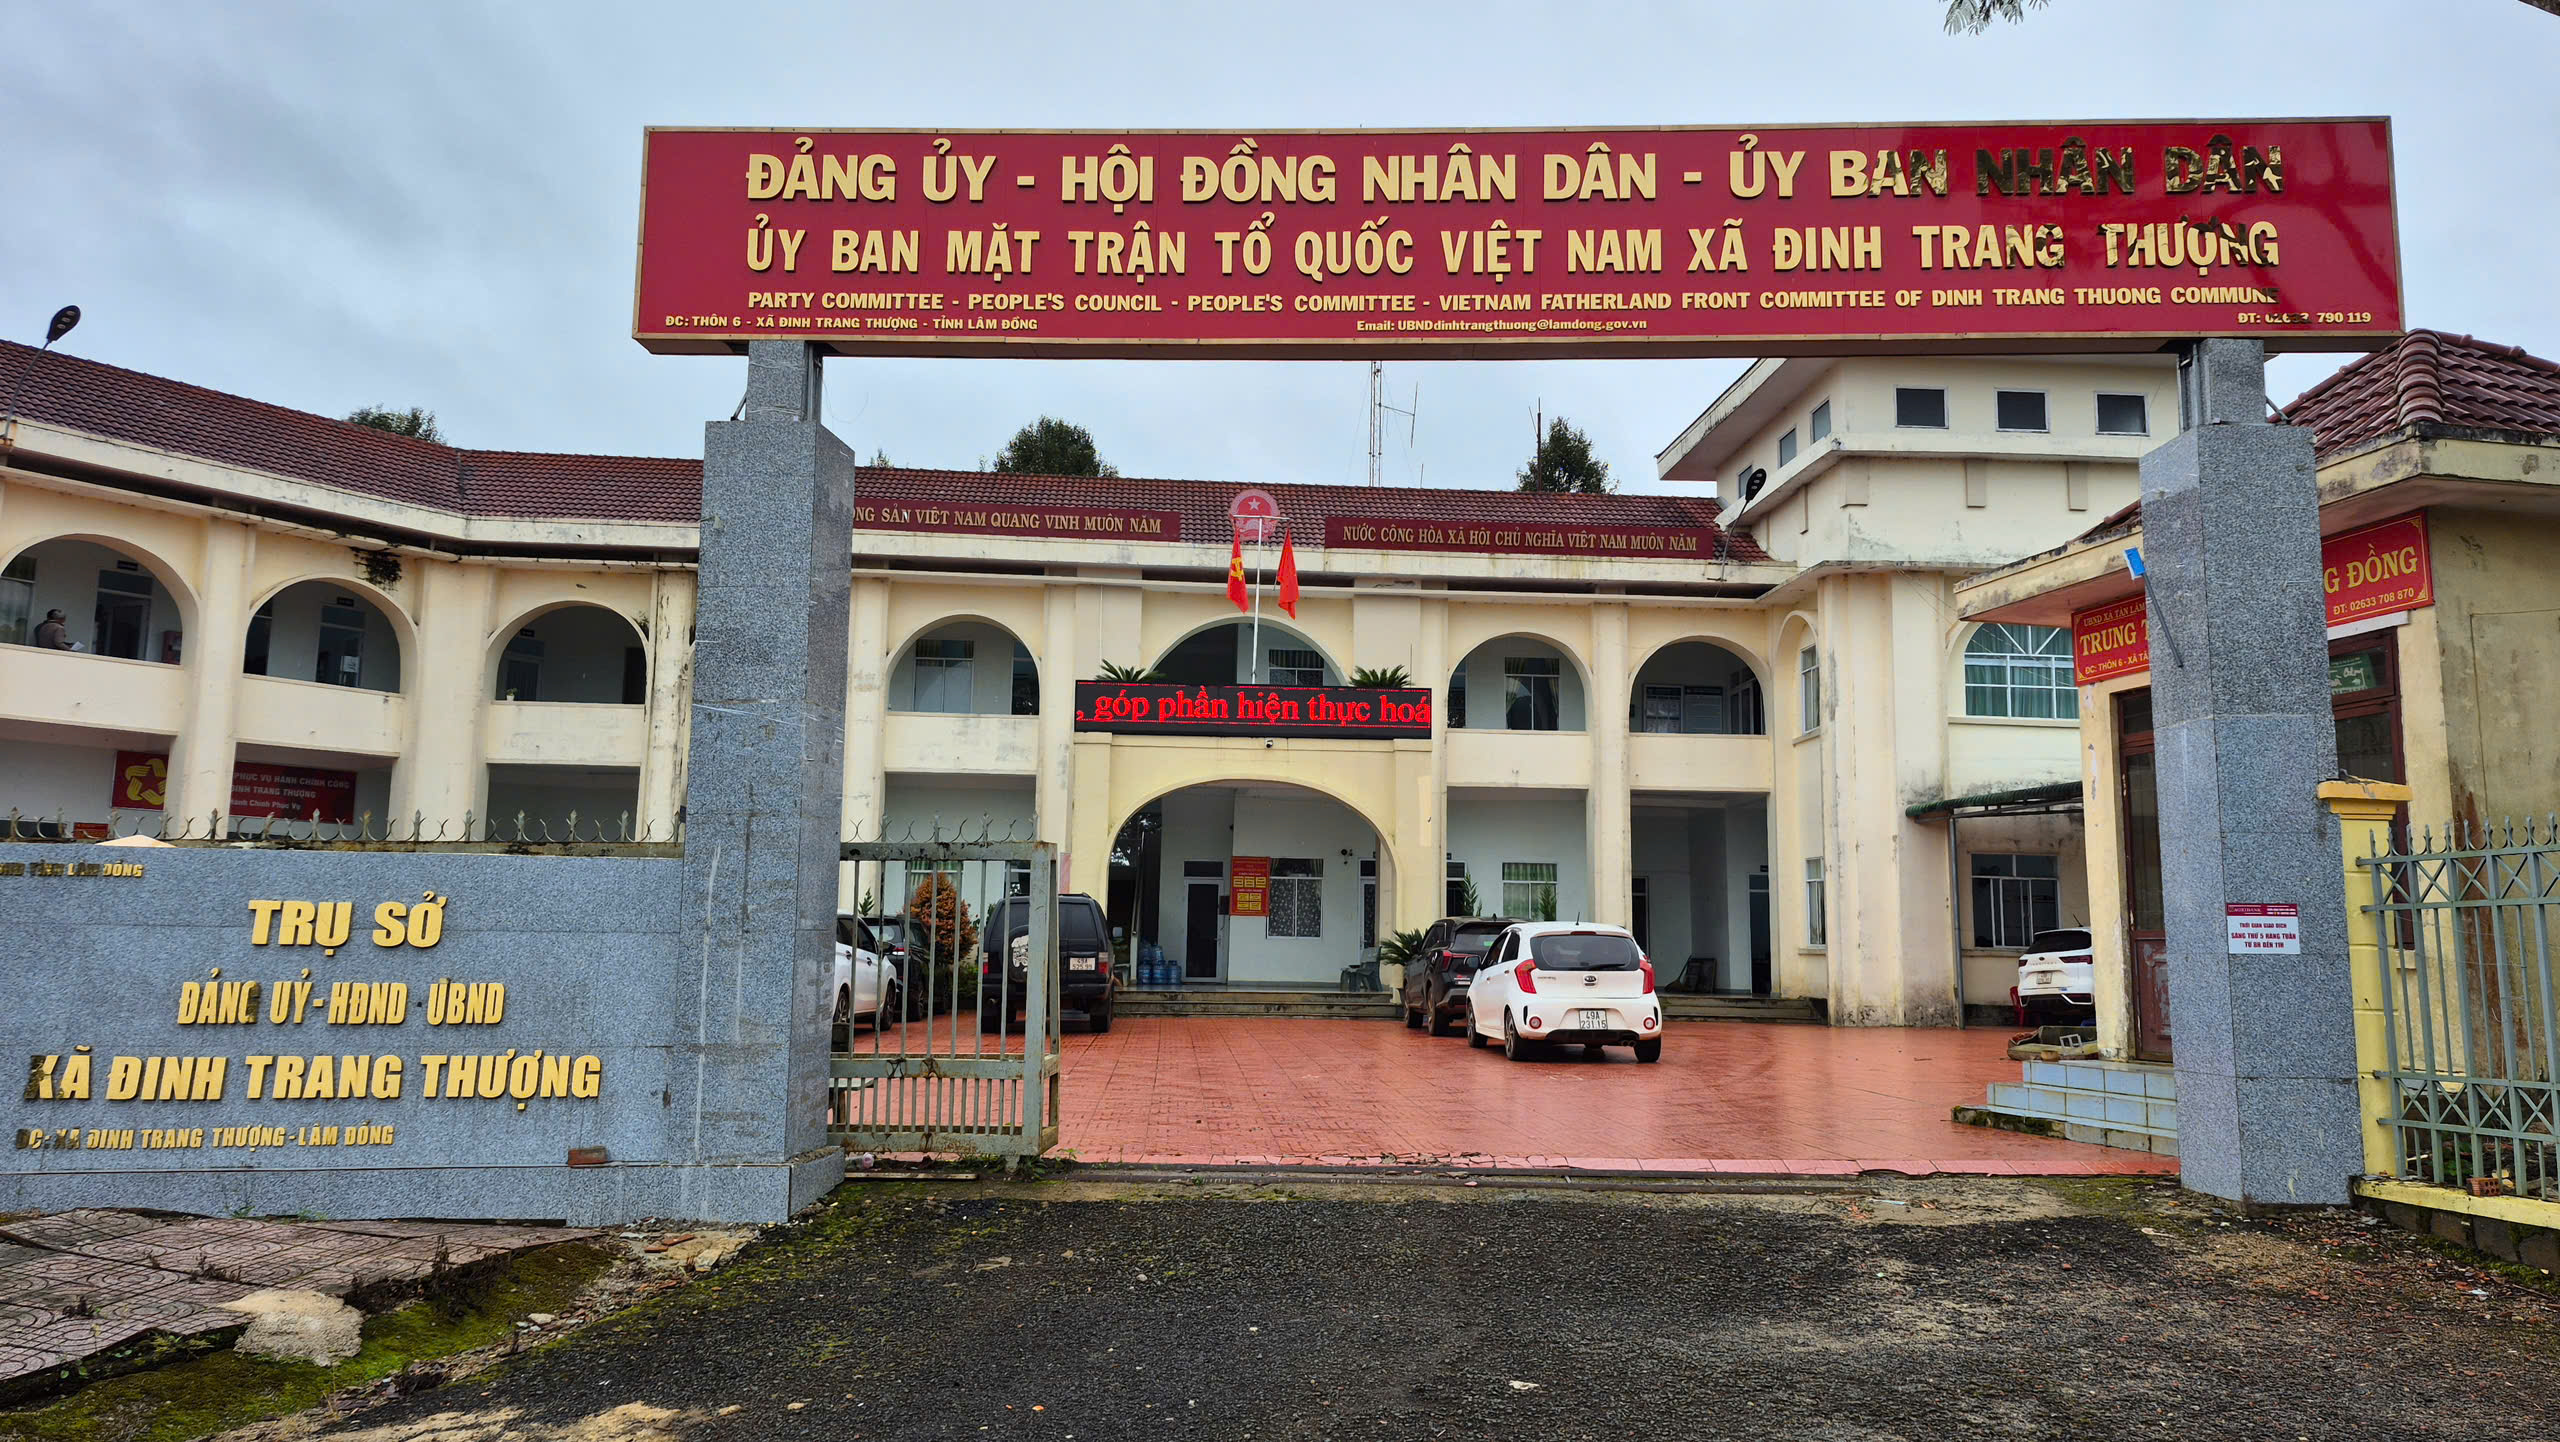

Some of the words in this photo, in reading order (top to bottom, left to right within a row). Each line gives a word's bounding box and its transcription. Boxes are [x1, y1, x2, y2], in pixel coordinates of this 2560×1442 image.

[746, 137, 897, 201] ĐẢNG
[922, 138, 996, 202] ỦY
[1062, 144, 1154, 213] HỘI
[1181, 138, 1335, 202] ĐỒNG
[1364, 143, 1516, 202] NHÂN
[1544, 142, 1656, 201] DÂN
[1730, 134, 1805, 199] ỦY
[1829, 149, 1948, 197] BAN
[1976, 136, 2134, 194] NHÂN
[2164, 134, 2284, 193] DÂN
[747, 213, 806, 272] ỦY
[832, 229, 918, 273] BAN
[946, 222, 1040, 282] MẶT
[1068, 221, 1186, 283] TRẬN
[1215, 211, 1275, 275] TỔ
[1295, 216, 1414, 282] QUỐC
[1440, 219, 1542, 282] VIỆT
[1568, 227, 1662, 273] NAM
[1687, 217, 1748, 272] XÃ
[1773, 226, 1882, 271] ĐINH
[1912, 223, 2065, 269] TRANG
[2097, 215, 2279, 276] THƯỢNG
[748, 292, 814, 309] PARTY
[821, 292, 944, 310] COMMITTEE
[968, 292, 1064, 311] PEOPLE'S
[1075, 294, 1162, 312] COUNCIL
[1187, 294, 1283, 312] PEOPLE'S
[1294, 294, 1416, 312] COMMITTEE
[1439, 293, 1531, 311] VIETNAM
[1541, 292, 1672, 310] FATHERLAND
[1682, 291, 1750, 309] FRONT
[1760, 290, 1885, 308] COMMITTEE
[1895, 289, 1922, 307] OF
[1932, 289, 1982, 306] DINH
[1992, 288, 2065, 306] TRANG
[2074, 287, 2161, 305] THUONG
[2171, 287, 2279, 304] COMMUNE
[665, 316, 689, 327] ĐC:
[692, 314, 728, 328] THÔN
[732, 316, 741, 327] 6
[756, 314, 775, 328] XÃ
[779, 317, 810, 328] ĐINH
[815, 317, 860, 329] TRANG
[865, 316, 918, 331] THƯỢNG
[932, 315, 963, 330] TỈNH
[968, 316, 997, 330] LÂM
[1001, 316, 1038, 330] ĐỒNG
[1357, 320, 1394, 331] Email:
[2238, 313, 2261, 323] ĐT:
[2317, 312, 2343, 323] 790
[2347, 312, 2371, 323] 119
[854, 507, 875, 522] NG
[882, 503, 911, 523] SẢN
[915, 506, 949, 525] VIỆT
[954, 511, 986, 527] NAM
[991, 512, 1040, 529] QUANG
[1044, 514, 1080, 530] VINH
[1084, 513, 1124, 532] MUÔN
[1130, 515, 1161, 533] NĂM
[1343, 523, 1376, 541] NƯỚC
[1381, 524, 1414, 544] CỘNG
[1419, 525, 1444, 544] HÒA
[1448, 527, 1466, 545] XÃ
[1495, 527, 1521, 546] CHỦ
[1525, 529, 1564, 547] NGHĨA
[1568, 530, 1596, 549] VIỆT
[1600, 535, 1627, 549] NAM
[1631, 532, 1664, 550] MUÔN
[1669, 533, 1697, 551] NĂM
[2346, 543, 2417, 588] ĐỒNG
[2333, 604, 2348, 615] ĐT:
[2350, 597, 2376, 611] 02633
[2378, 592, 2395, 604] 708
[2397, 588, 2414, 600] 870
[2080, 623, 2137, 656] TRUNG
[1095, 690, 1150, 722] góp
[1158, 686, 1228, 723] phần
[1237, 692, 1298, 724] hiện
[1308, 695, 1370, 726] thực
[1379, 695, 1431, 724] hoá
[248, 900, 353, 956] TRỤ
[372, 890, 447, 948] SỞ
[1586, 1011, 1600, 1019] 49A
[24, 1045, 91, 1099] XÃ
[106, 1056, 227, 1100] ĐINH
[245, 1055, 402, 1098] TRANG
[420, 1048, 601, 1110] THƯỢNG
[141, 1128, 203, 1149] TRANG
